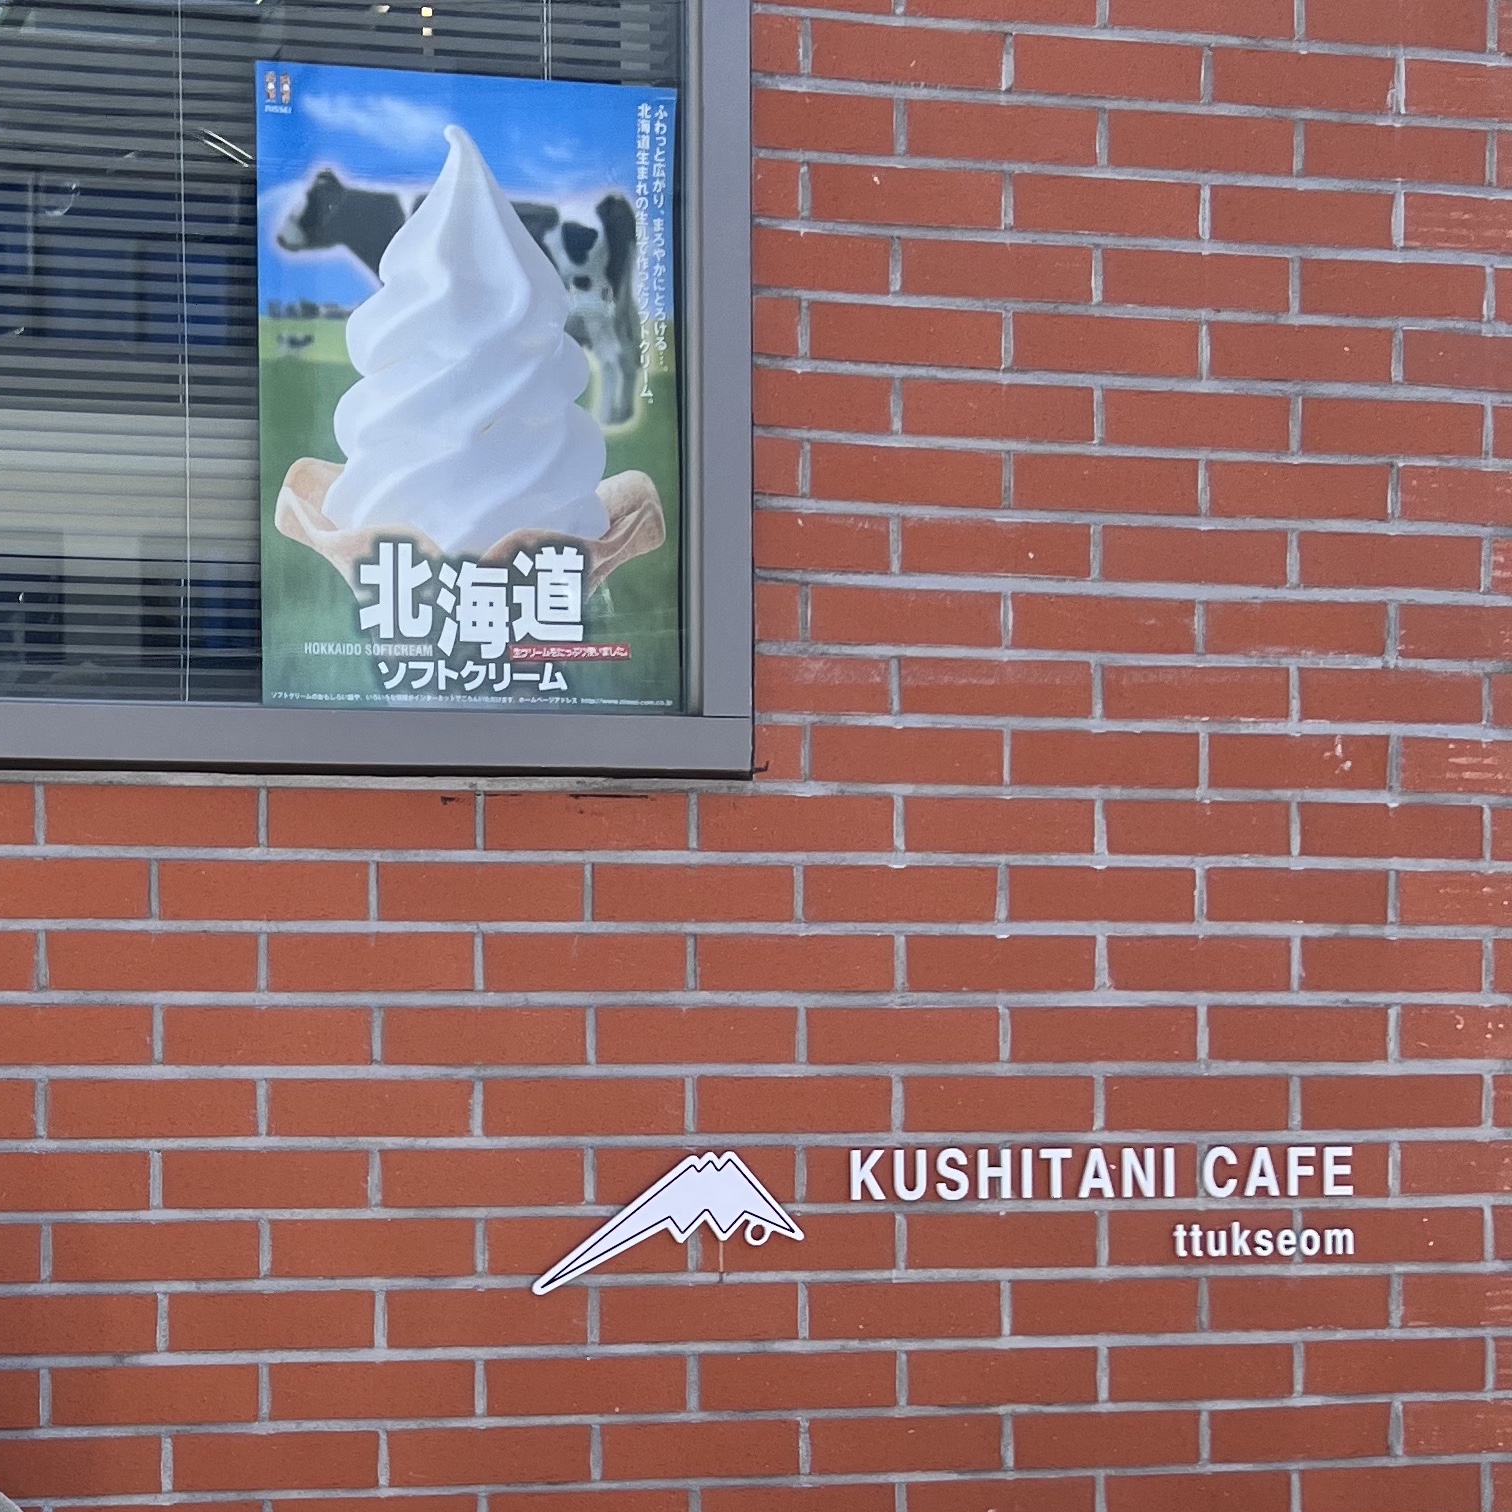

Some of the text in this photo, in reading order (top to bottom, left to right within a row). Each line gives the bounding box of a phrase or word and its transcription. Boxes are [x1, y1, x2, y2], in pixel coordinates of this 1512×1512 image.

[359, 541, 585, 659] 北海道
[304, 642, 434, 657] HOKKAIDO SOFTCREAM
[378, 661, 569, 692] ソフトクリーム
[849, 1145, 1355, 1201] KUSHITANI CAFE
[1173, 1221, 1356, 1257] ttukseom
